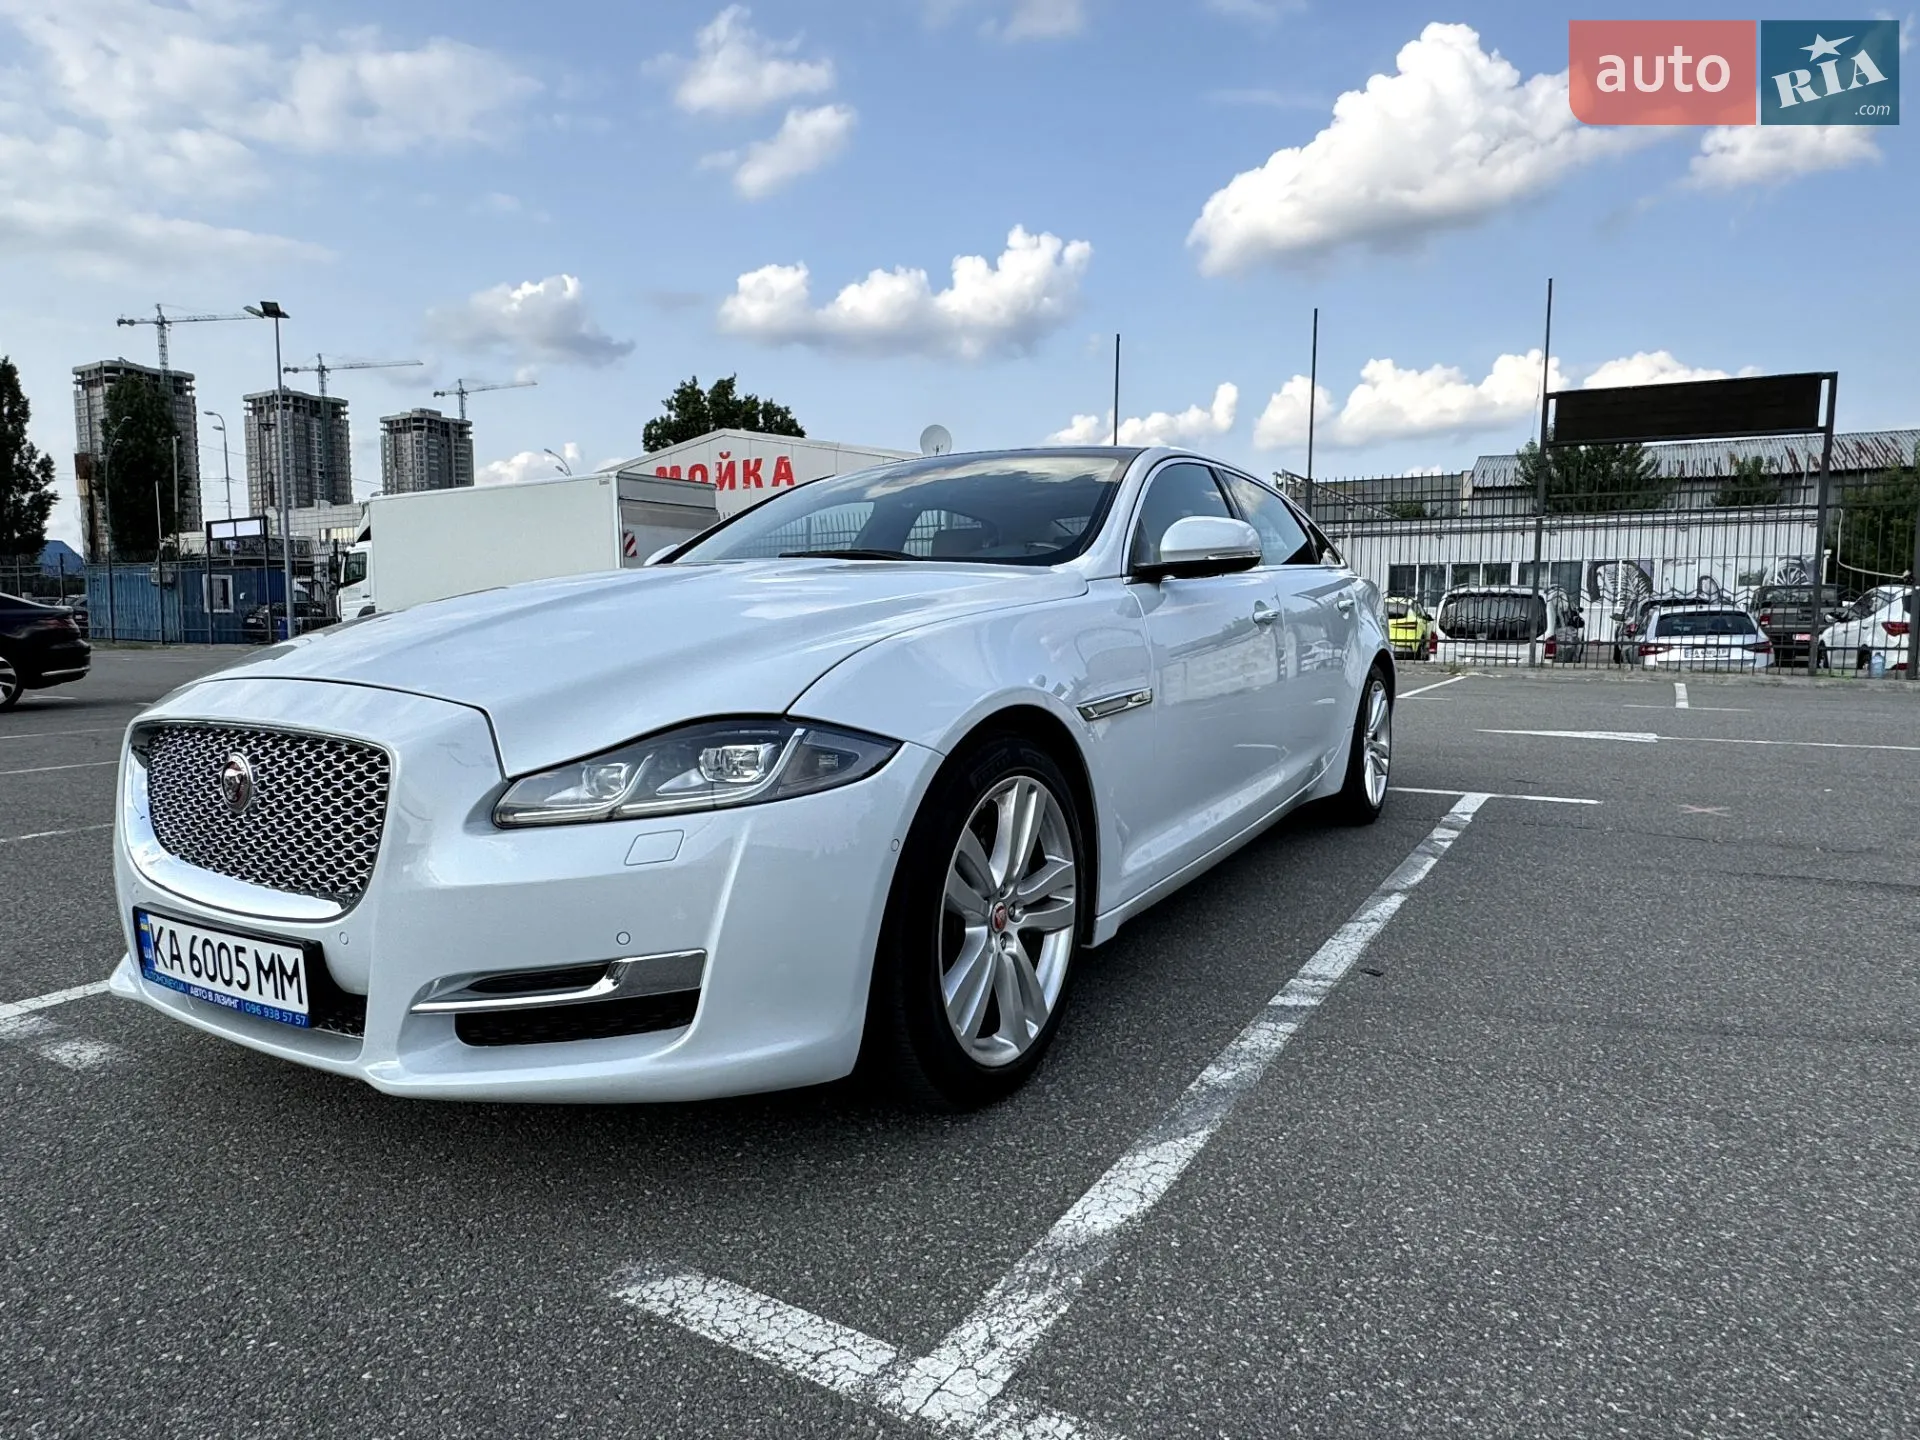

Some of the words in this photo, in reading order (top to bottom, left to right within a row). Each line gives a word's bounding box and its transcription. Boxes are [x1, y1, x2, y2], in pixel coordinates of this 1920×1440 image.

[150, 923, 186, 975] KA
[189, 935, 250, 992] 6005
[254, 949, 304, 1005] MM
[190, 985, 207, 1000] АВТО
[245, 1002, 262, 1015] 096
[263, 1007, 280, 1020] 938
[282, 1012, 293, 1023] 57
[295, 1015, 306, 1026] 57
